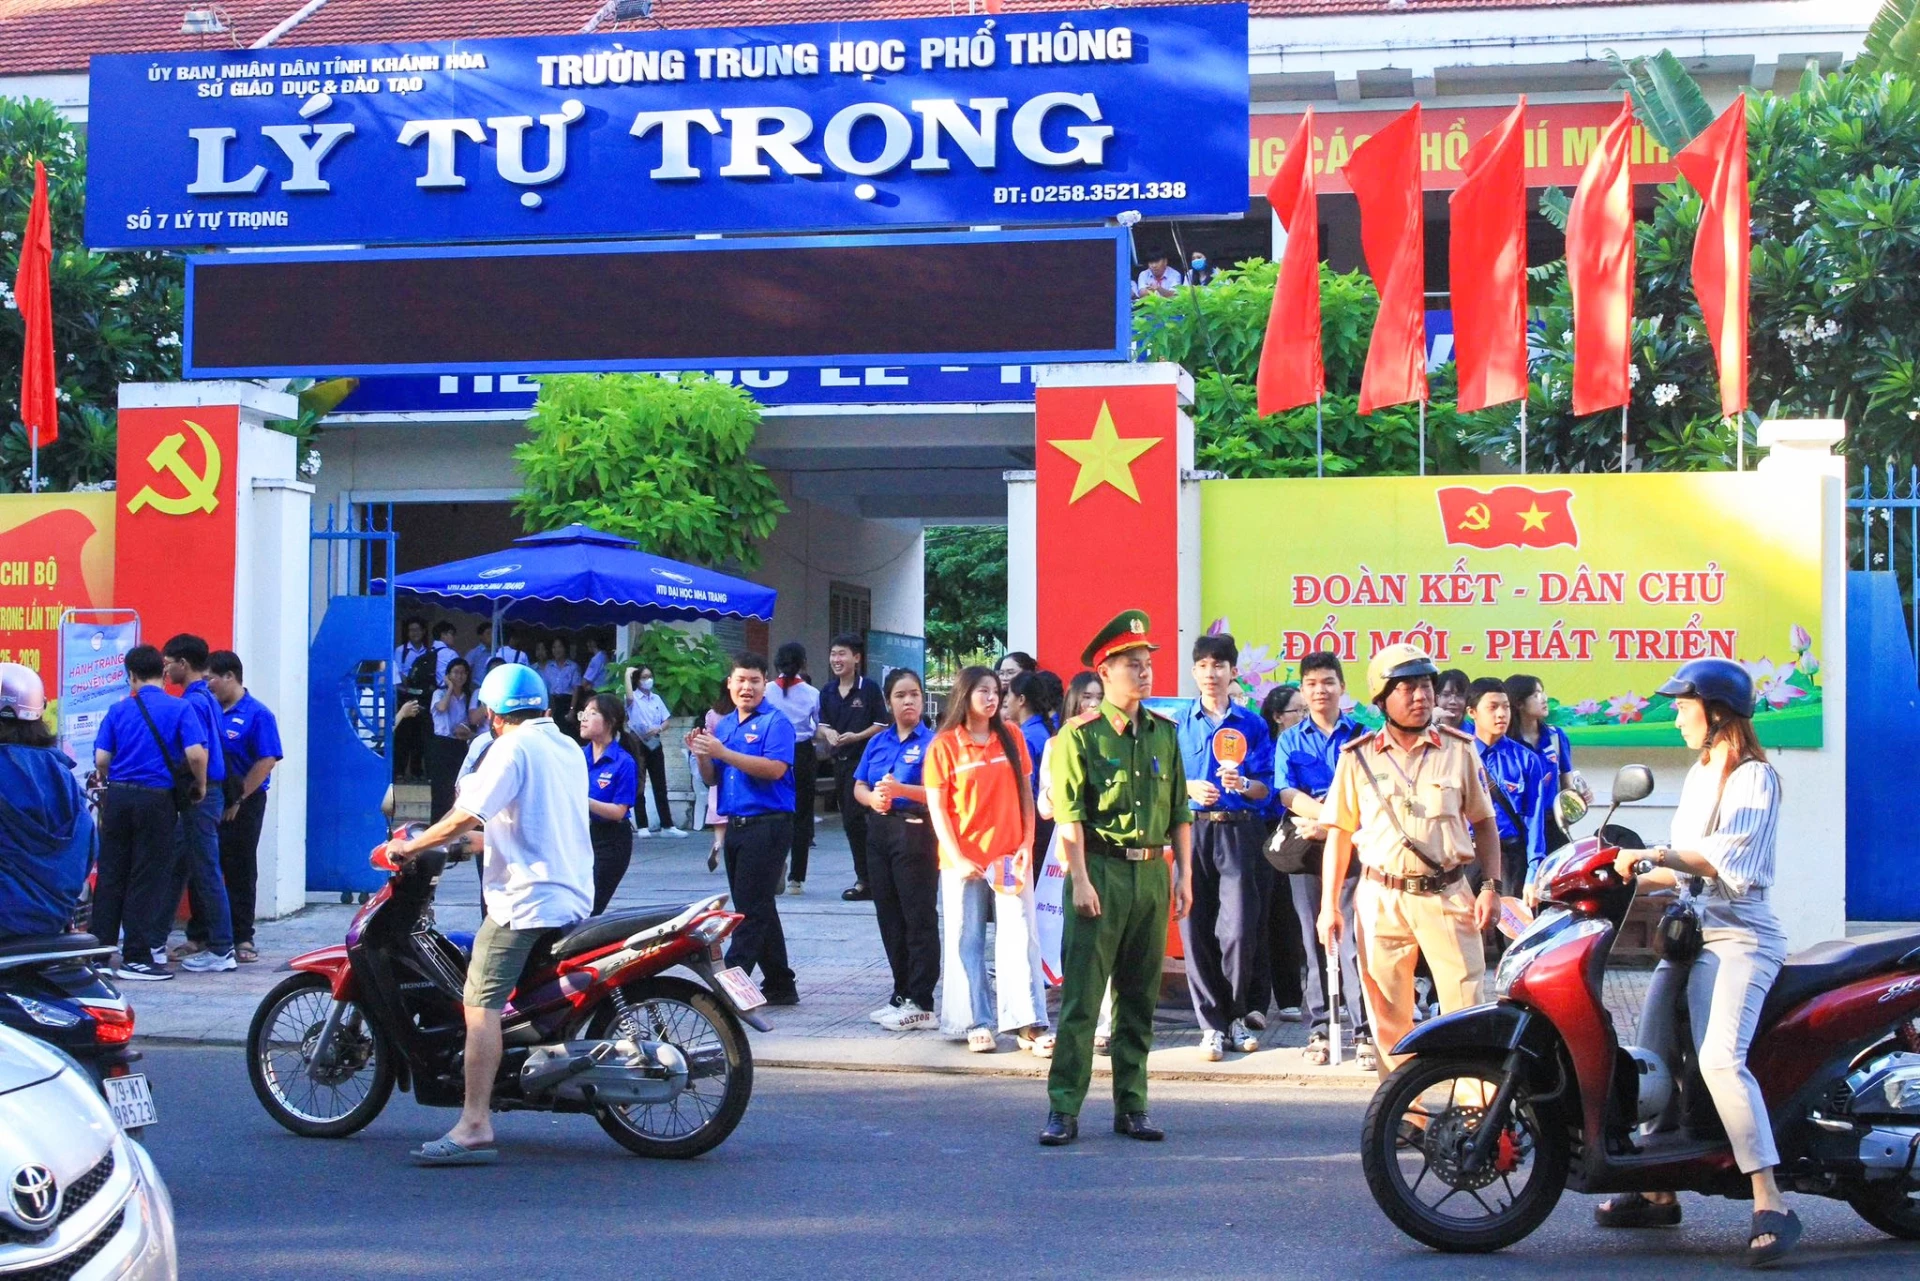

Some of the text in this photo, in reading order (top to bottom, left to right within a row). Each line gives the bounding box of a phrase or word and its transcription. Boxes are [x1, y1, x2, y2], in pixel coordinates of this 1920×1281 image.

[537, 19, 1132, 86] TRƯỜNG TRUNG HỌC PHỔ THÔNG
[148, 53, 486, 82] ỦY BAN NHÂN DÂN TỈNH KHÁNH HÒA
[197, 76, 423, 98] SỞ GIÁO DỤC & ĐÀO TẠO
[187, 91, 1115, 209] LÝ TỰ TRỌNG
[994, 182, 1186, 204] ĐT: 0258.3521.338
[126, 206, 288, 231] SỐ 7 LÝ TỰ TRỌNG
[0, 556, 57, 590] CHI BỘ
[1292, 565, 1407, 605] ĐOÀN
[1419, 557, 1501, 604] KẾT
[1538, 564, 1625, 603] DÂN
[1638, 562, 1725, 603] CHỦ
[680, 588, 693, 601] HỌC
[707, 591, 727, 604] TRANG
[0, 606, 24, 636] RỌNG
[1283, 615, 1356, 660] ĐỔI
[1486, 620, 1597, 660] PHÁT
[1608, 613, 1735, 660] TRIỂN
[95, 653, 126, 671] TRANG
[400, 981, 435, 990] HONDA
[899, 1012, 930, 1027] BOSTON
